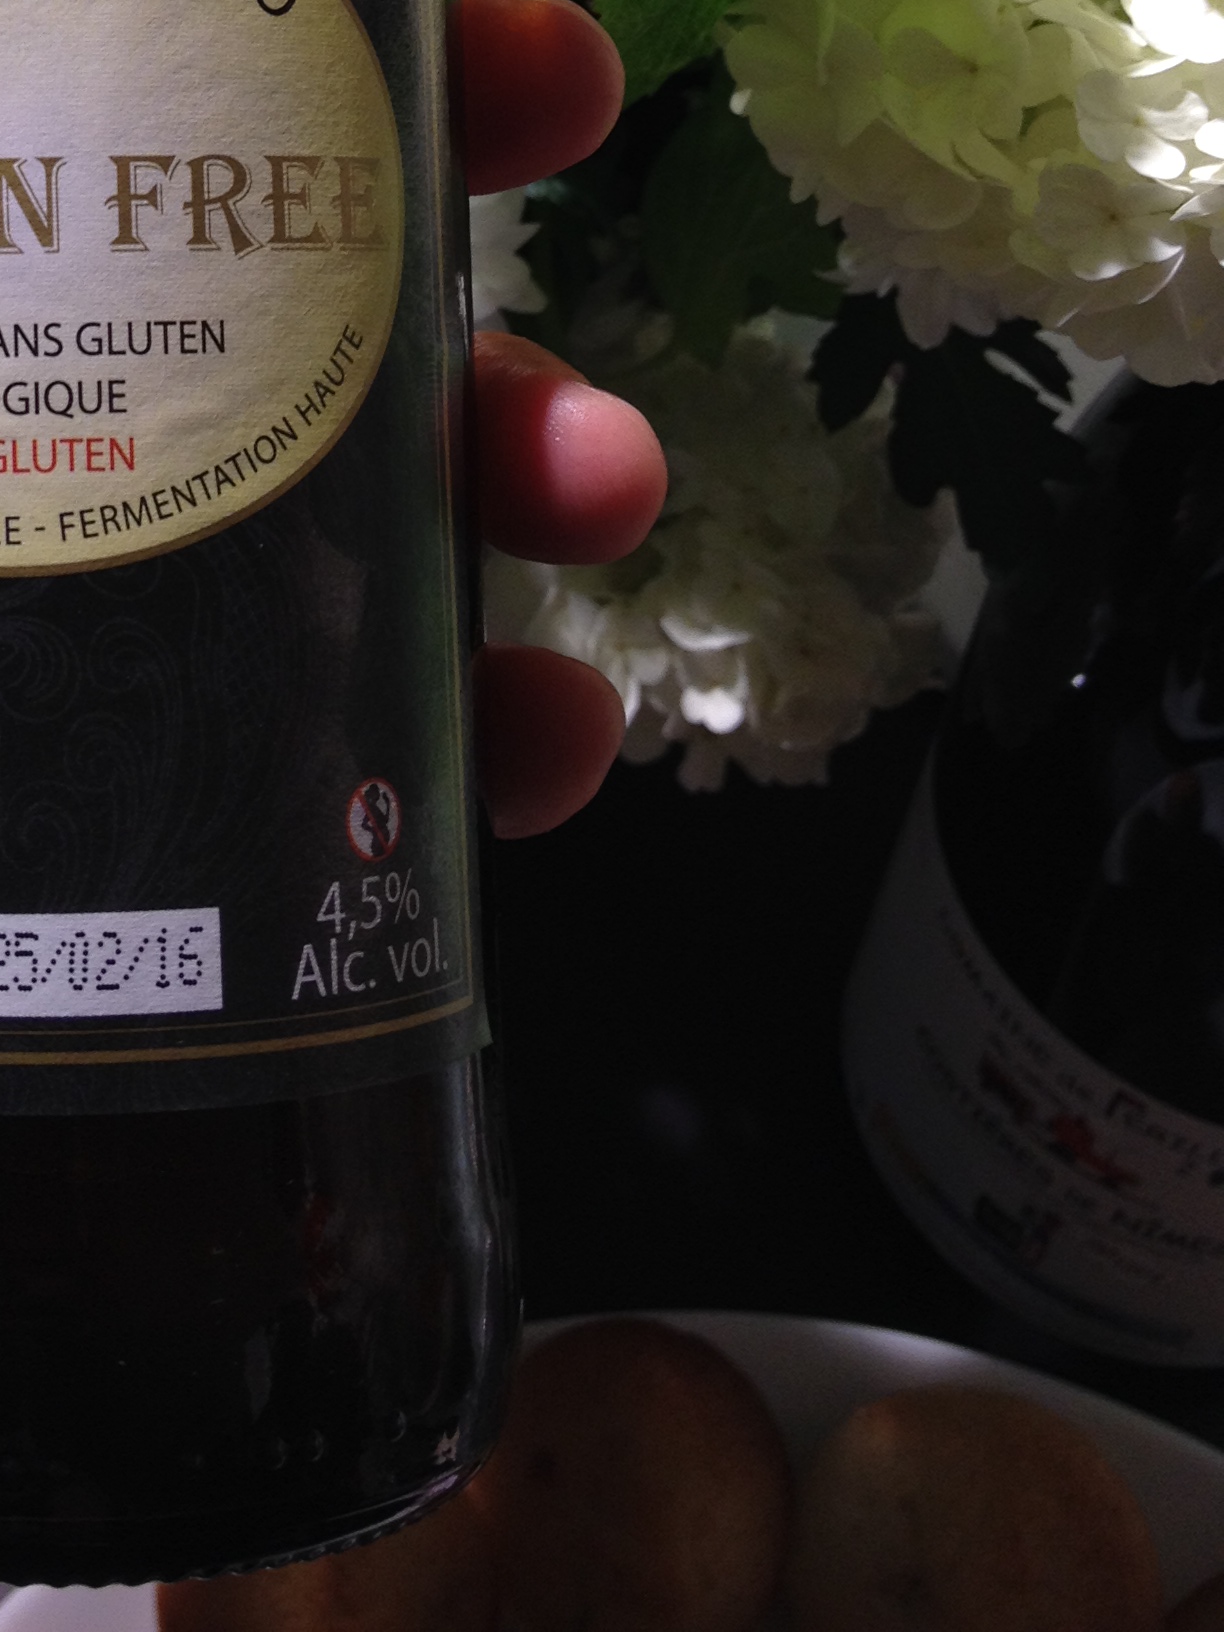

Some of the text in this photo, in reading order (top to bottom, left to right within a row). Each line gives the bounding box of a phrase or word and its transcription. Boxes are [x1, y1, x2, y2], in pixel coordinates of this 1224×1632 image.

[103, 154, 389, 261] FREE
[75, 318, 227, 357] GLUTEN
[58, 416, 301, 544] FERMENTATION
[294, 323, 366, 426] HAUTE
[315, 868, 421, 941] 4,5%
[290, 917, 450, 1001] Alc. vol.
